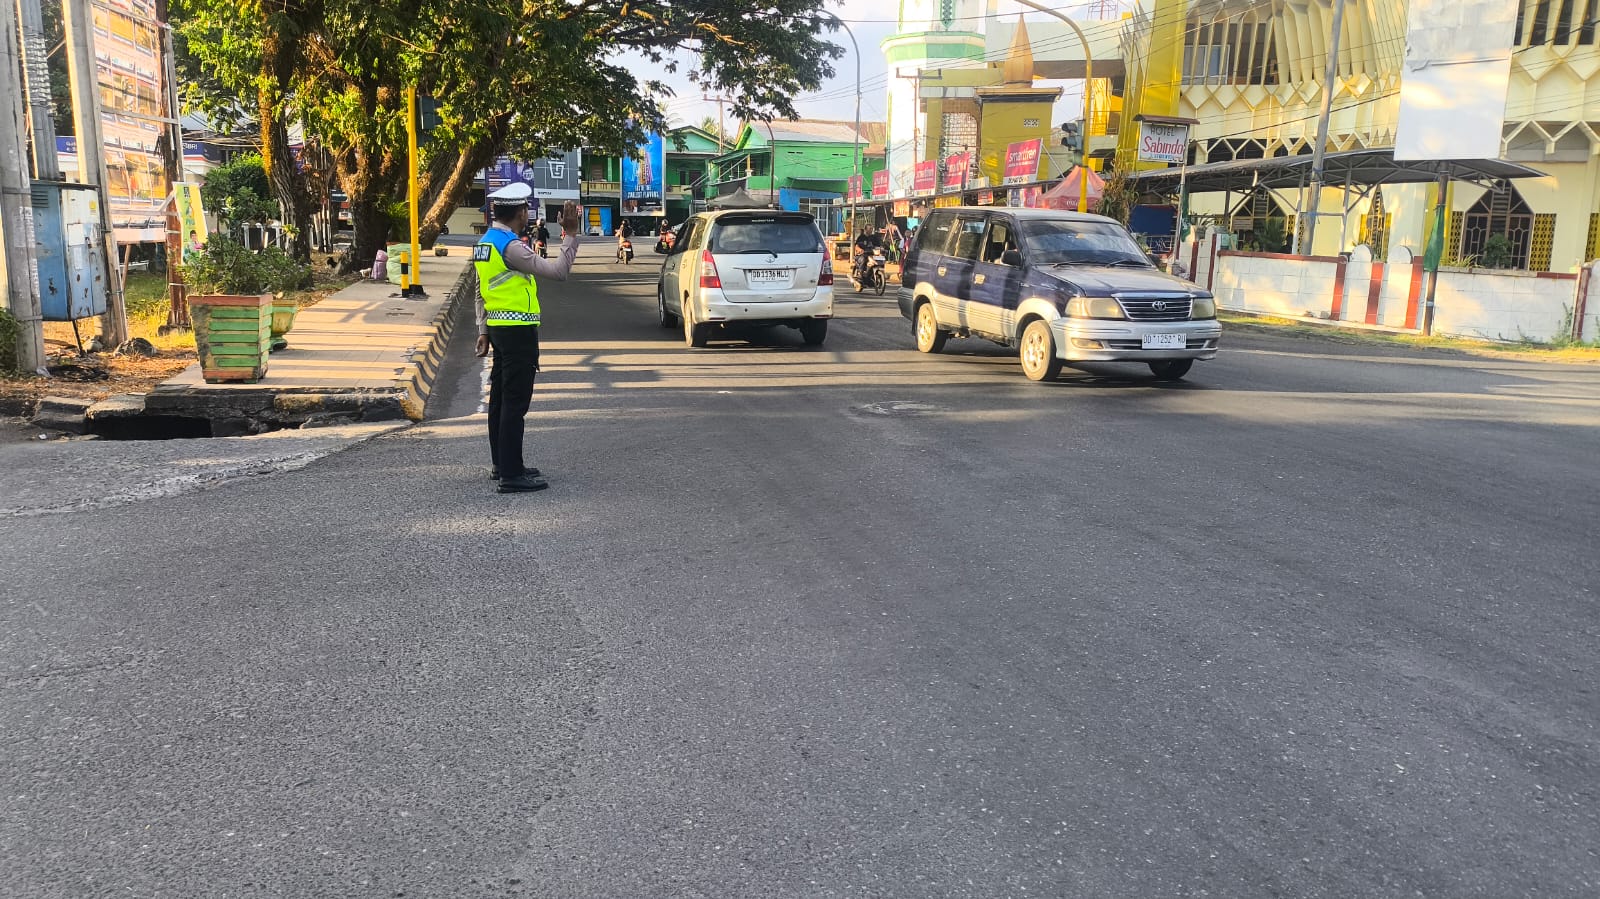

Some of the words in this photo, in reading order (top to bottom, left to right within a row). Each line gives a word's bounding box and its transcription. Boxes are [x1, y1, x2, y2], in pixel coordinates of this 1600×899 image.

[1150, 126, 1175, 136] HOTEL
[1142, 136, 1184, 154] Sabindo
[1009, 147, 1037, 162] smartfren
[1143, 334, 1152, 344] DD
[1157, 334, 1171, 344] 1252
